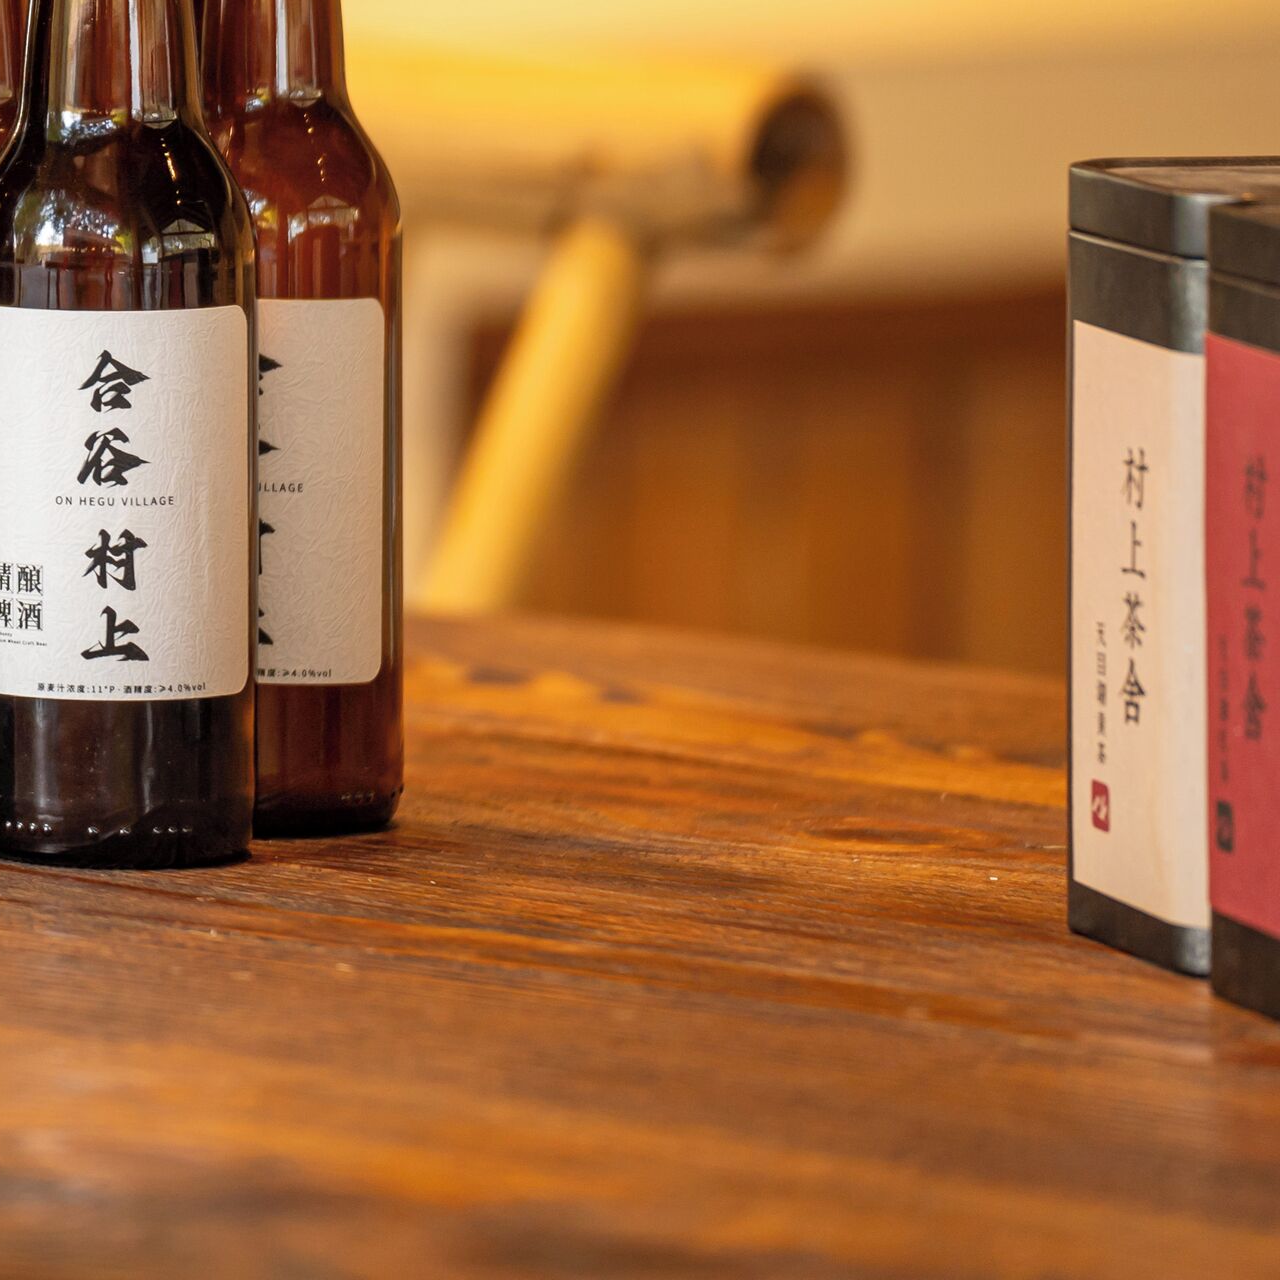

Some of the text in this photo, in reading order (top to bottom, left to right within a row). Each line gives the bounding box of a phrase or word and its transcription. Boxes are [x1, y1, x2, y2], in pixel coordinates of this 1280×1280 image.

[258, 482, 304, 493] ILLAGE
[55, 495, 174, 507] ON HEGU VILLAGE
[77, 349, 151, 662] 合谷村上
